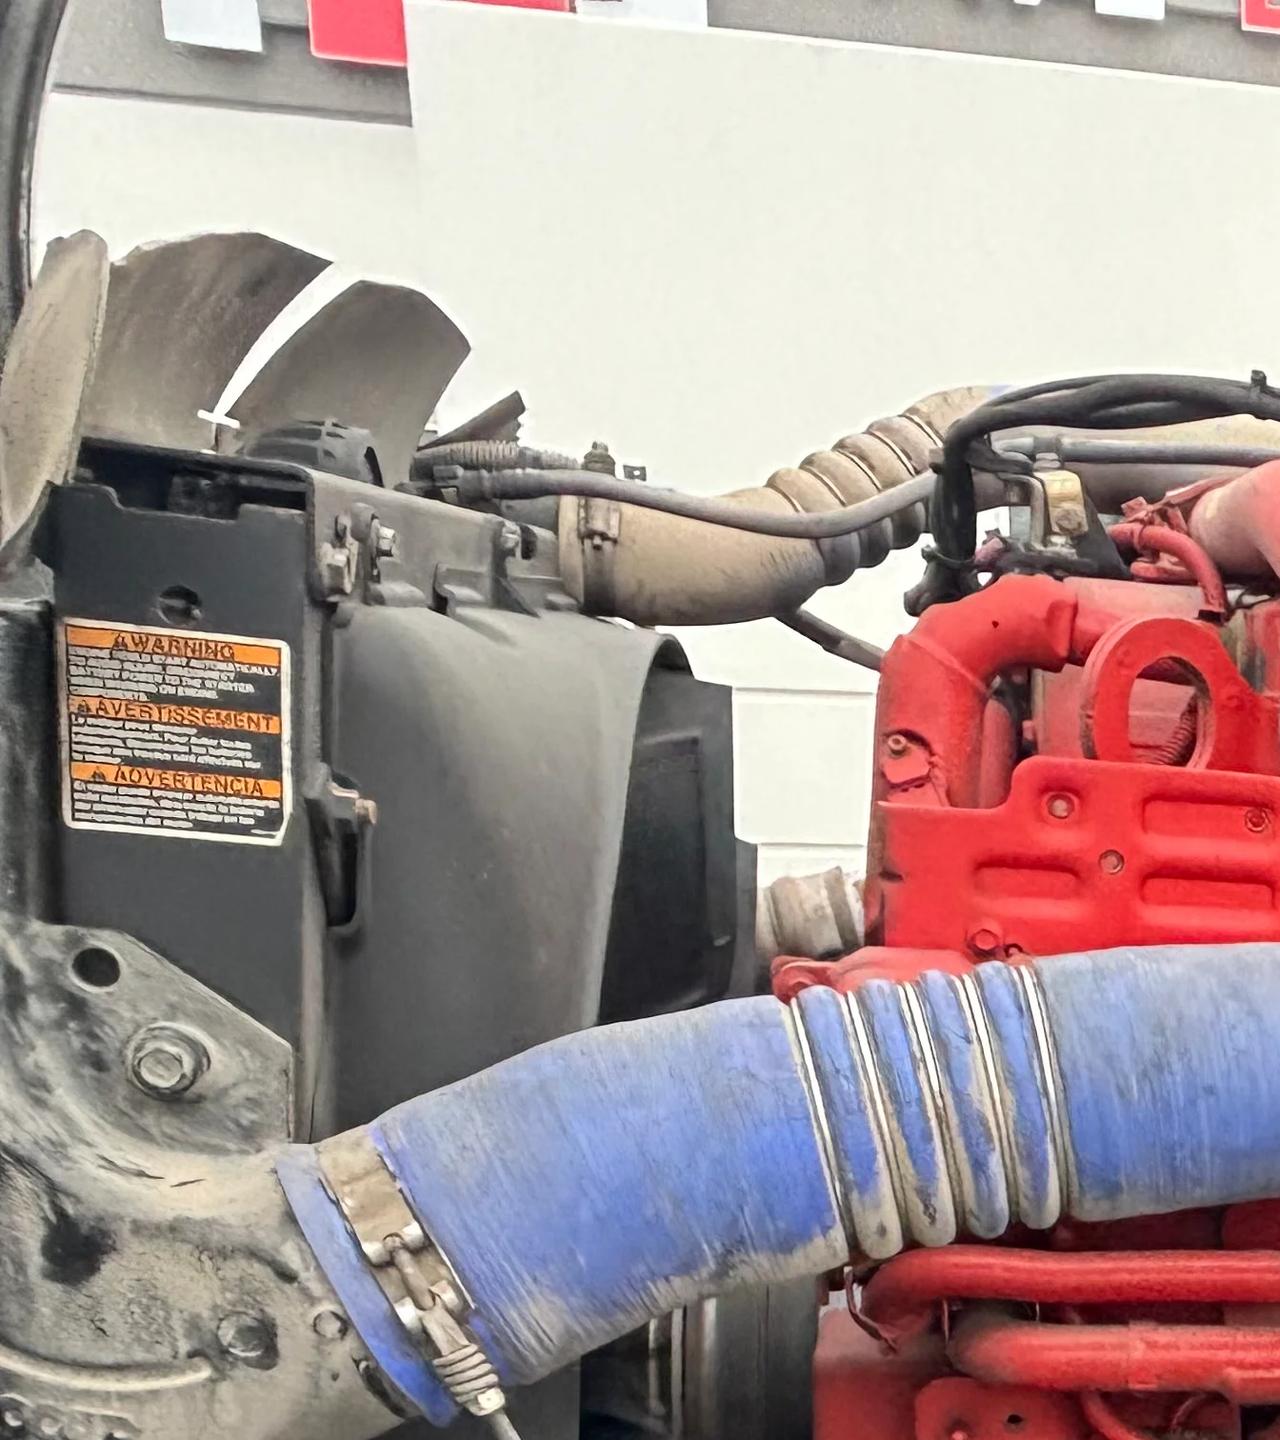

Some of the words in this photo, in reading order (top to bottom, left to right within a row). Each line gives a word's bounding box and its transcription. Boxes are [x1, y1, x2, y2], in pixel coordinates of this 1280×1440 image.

[130, 634, 235, 661] WARNING
[96, 701, 274, 731] AVERTISSEMENT
[113, 766, 264, 796] ADVERTENCIA
